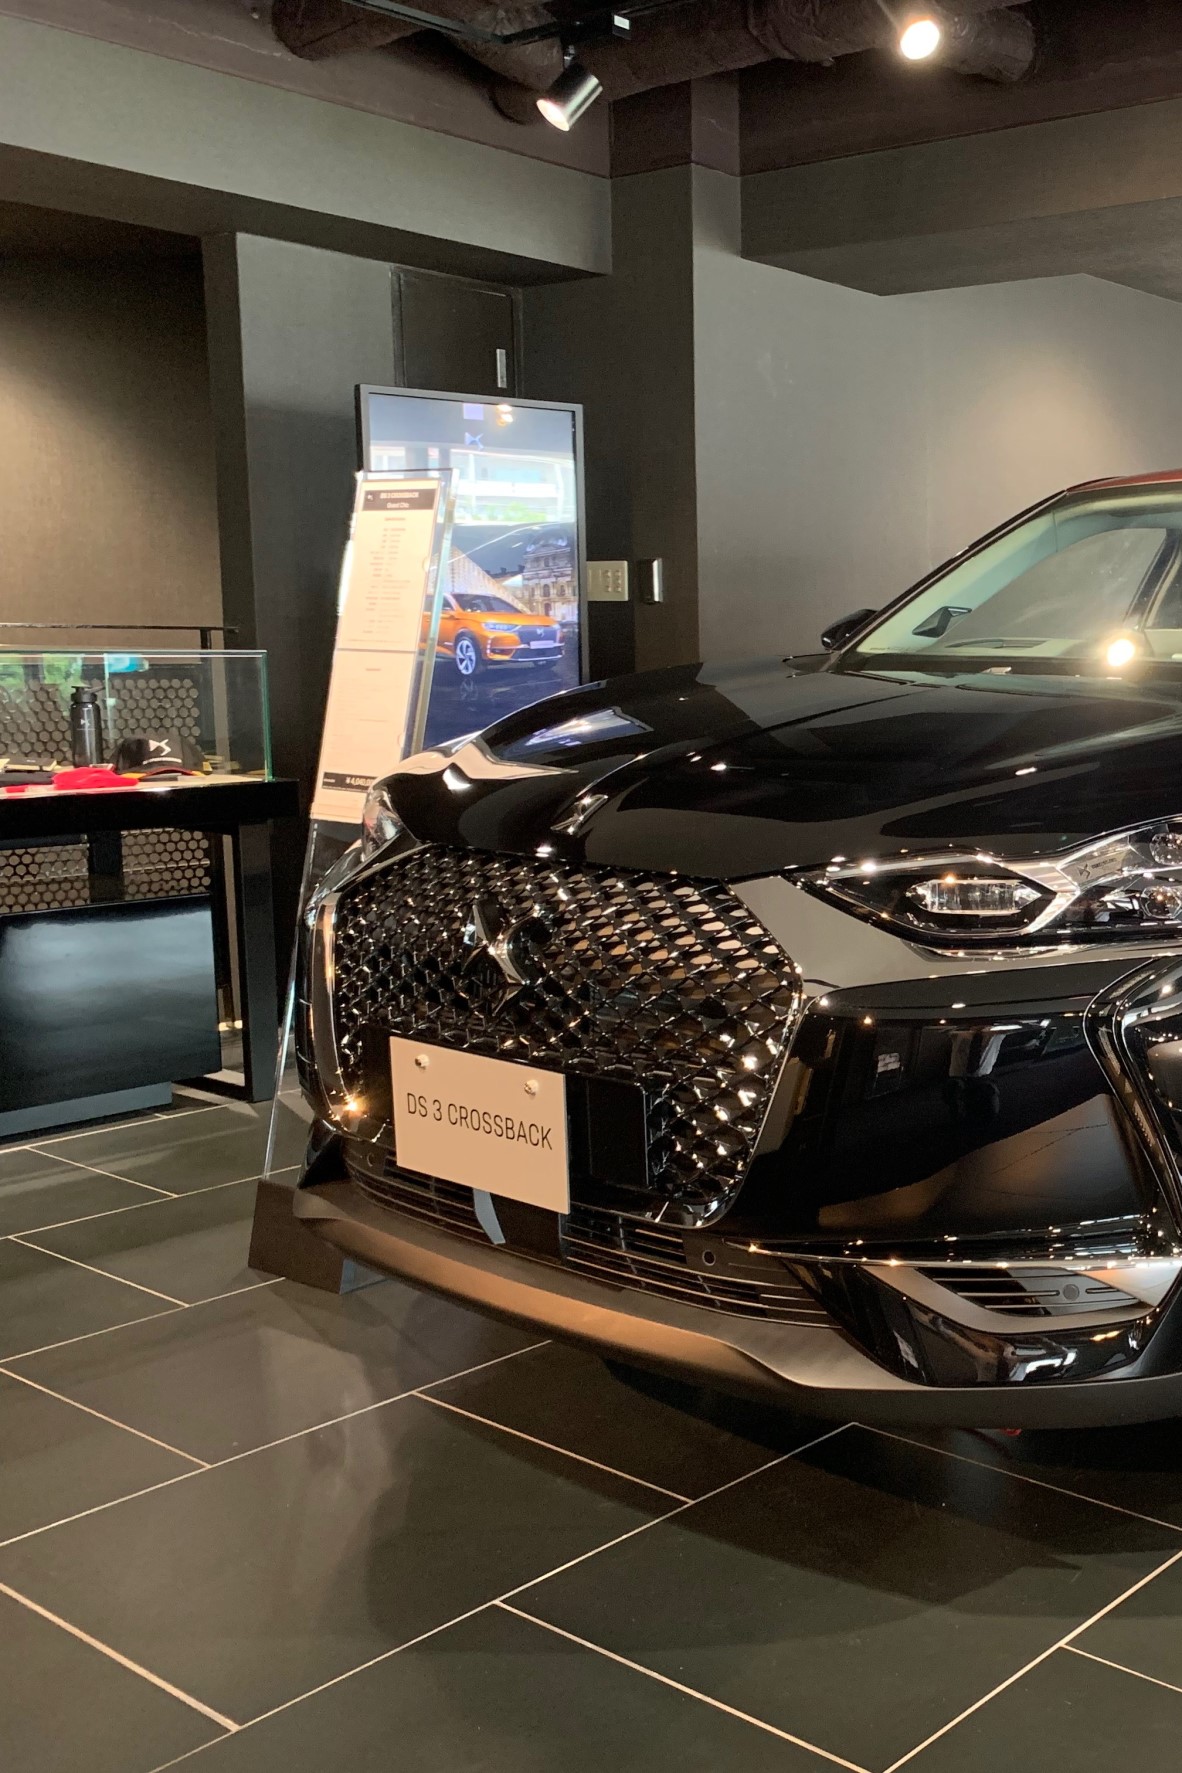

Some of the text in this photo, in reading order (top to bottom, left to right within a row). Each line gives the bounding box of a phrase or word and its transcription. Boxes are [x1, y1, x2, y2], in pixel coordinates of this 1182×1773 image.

[407, 1092, 553, 1151] DS 3 CROSSBACK
